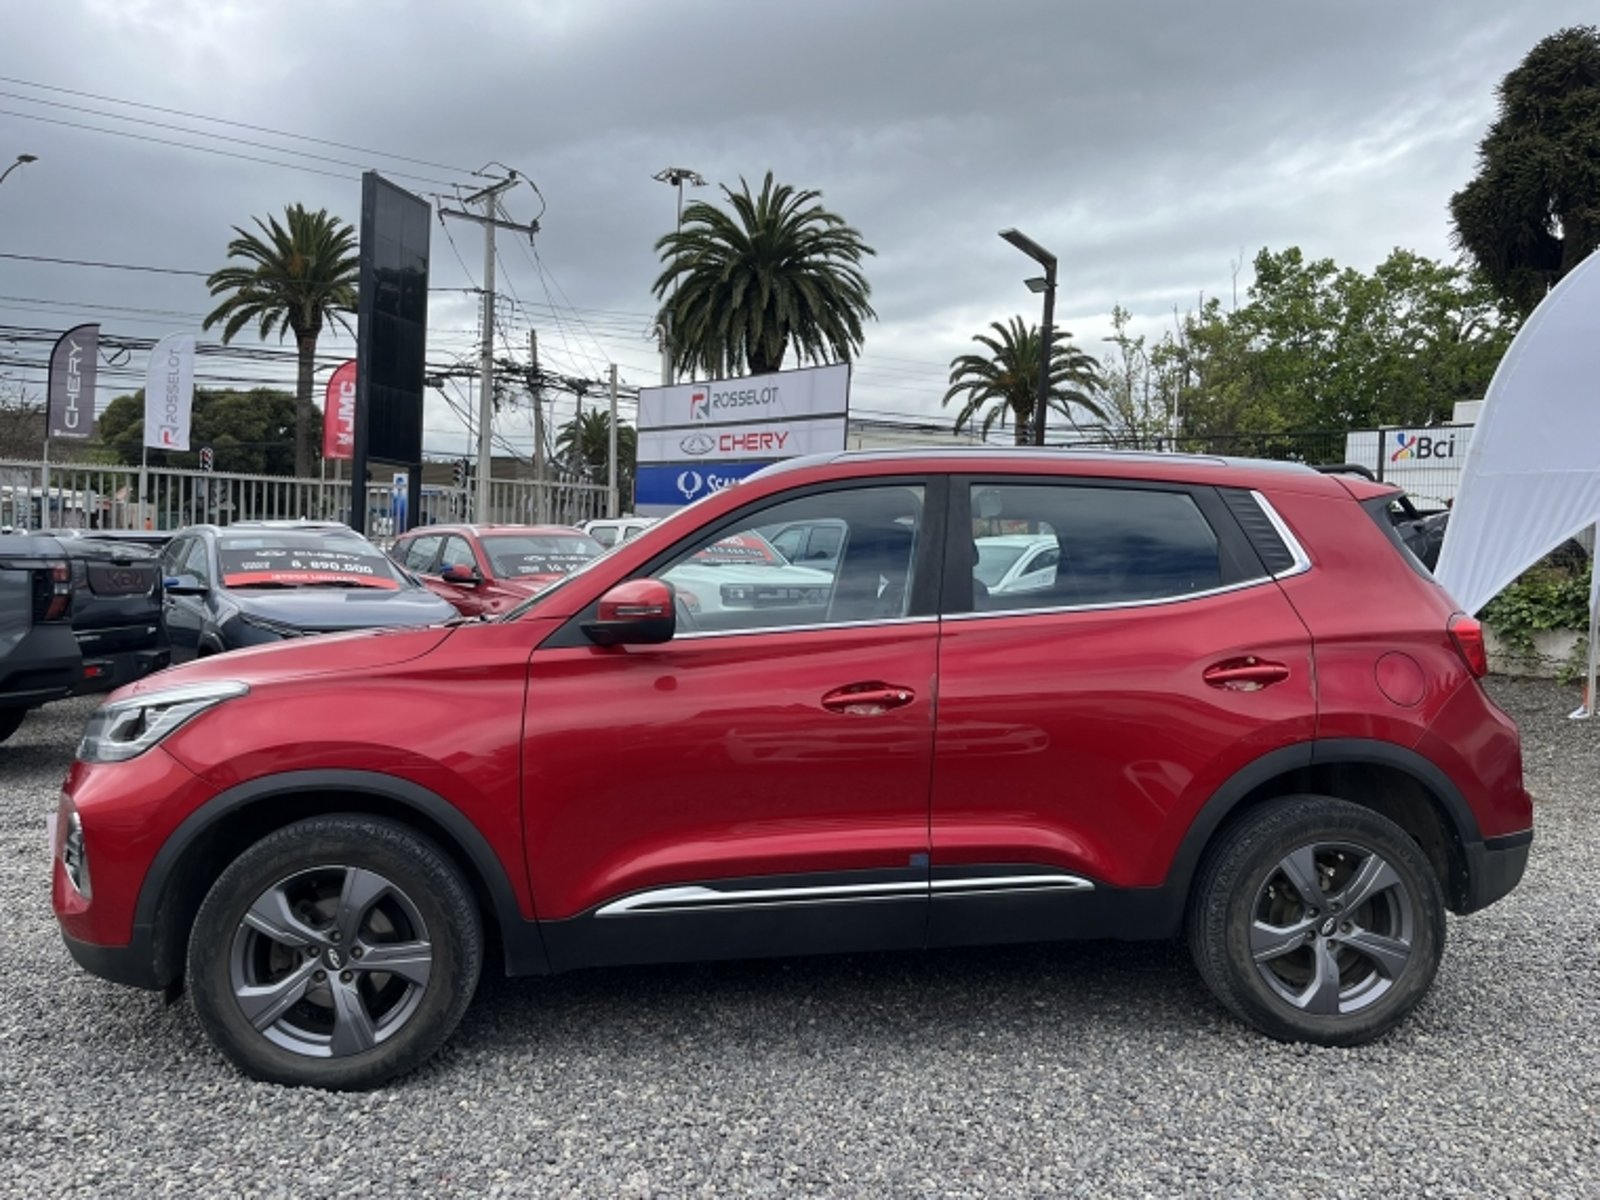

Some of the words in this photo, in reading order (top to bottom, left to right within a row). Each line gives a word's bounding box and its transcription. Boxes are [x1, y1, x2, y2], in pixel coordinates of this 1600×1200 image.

[65, 340, 82, 428] CHERY
[166, 348, 180, 424] ROSSELOT
[713, 387, 779, 409] ROSSELOT
[338, 381, 357, 432] JMC
[719, 431, 789, 452] CHERY
[1417, 434, 1455, 459] Bci
